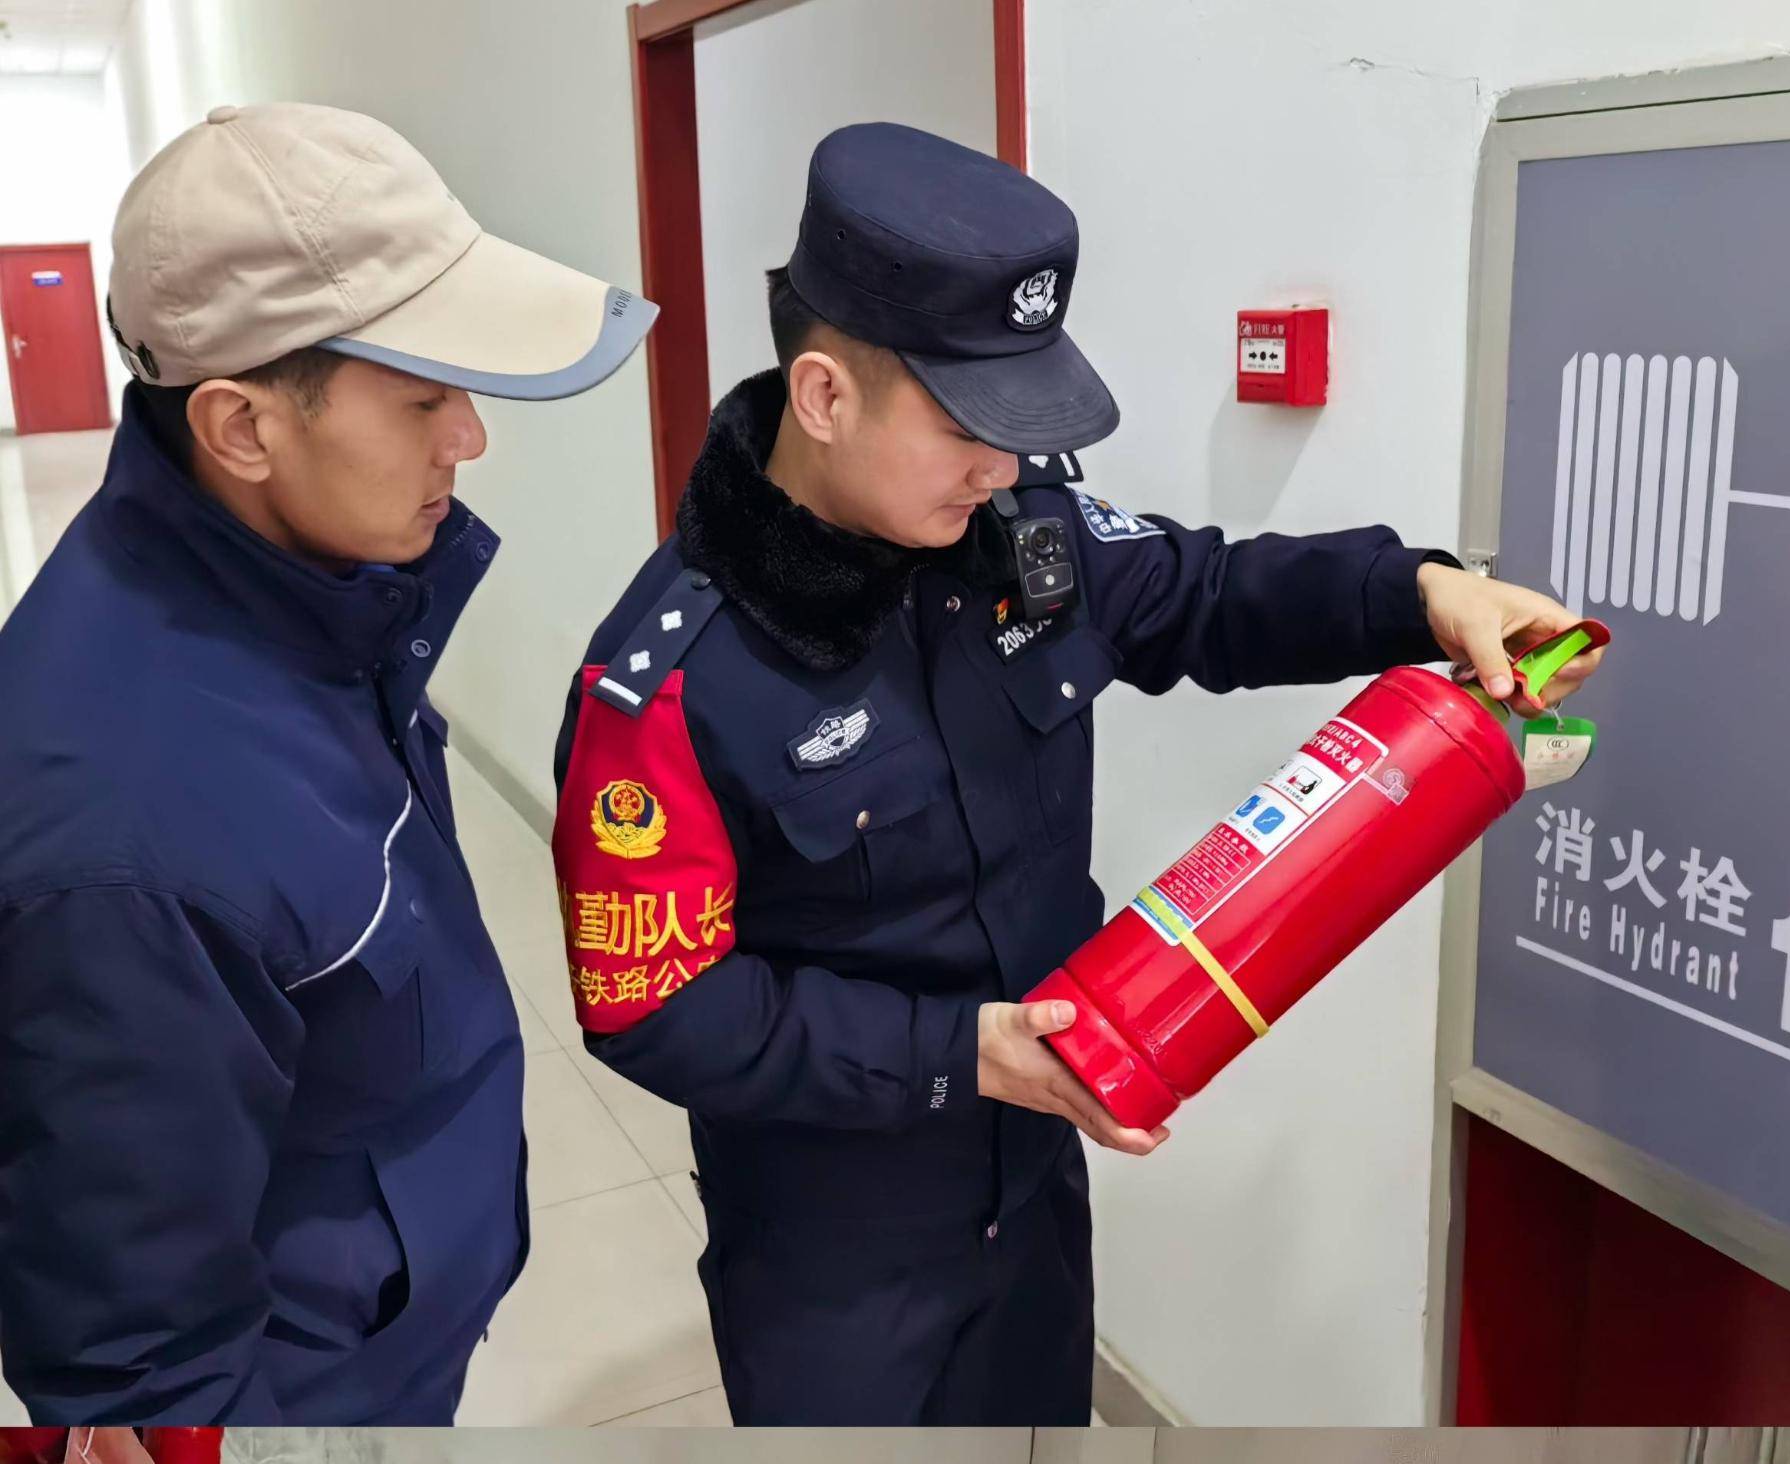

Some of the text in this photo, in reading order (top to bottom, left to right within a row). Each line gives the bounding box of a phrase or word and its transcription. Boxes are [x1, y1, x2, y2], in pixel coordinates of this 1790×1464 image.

[1535, 801, 1753, 937] 消火栓
[557, 880, 734, 958] 勤队长
[1535, 876, 1740, 1001] Fire Hydrant
[570, 955, 722, 1006] 铁路公
[930, 1075, 948, 1110] POLICE
